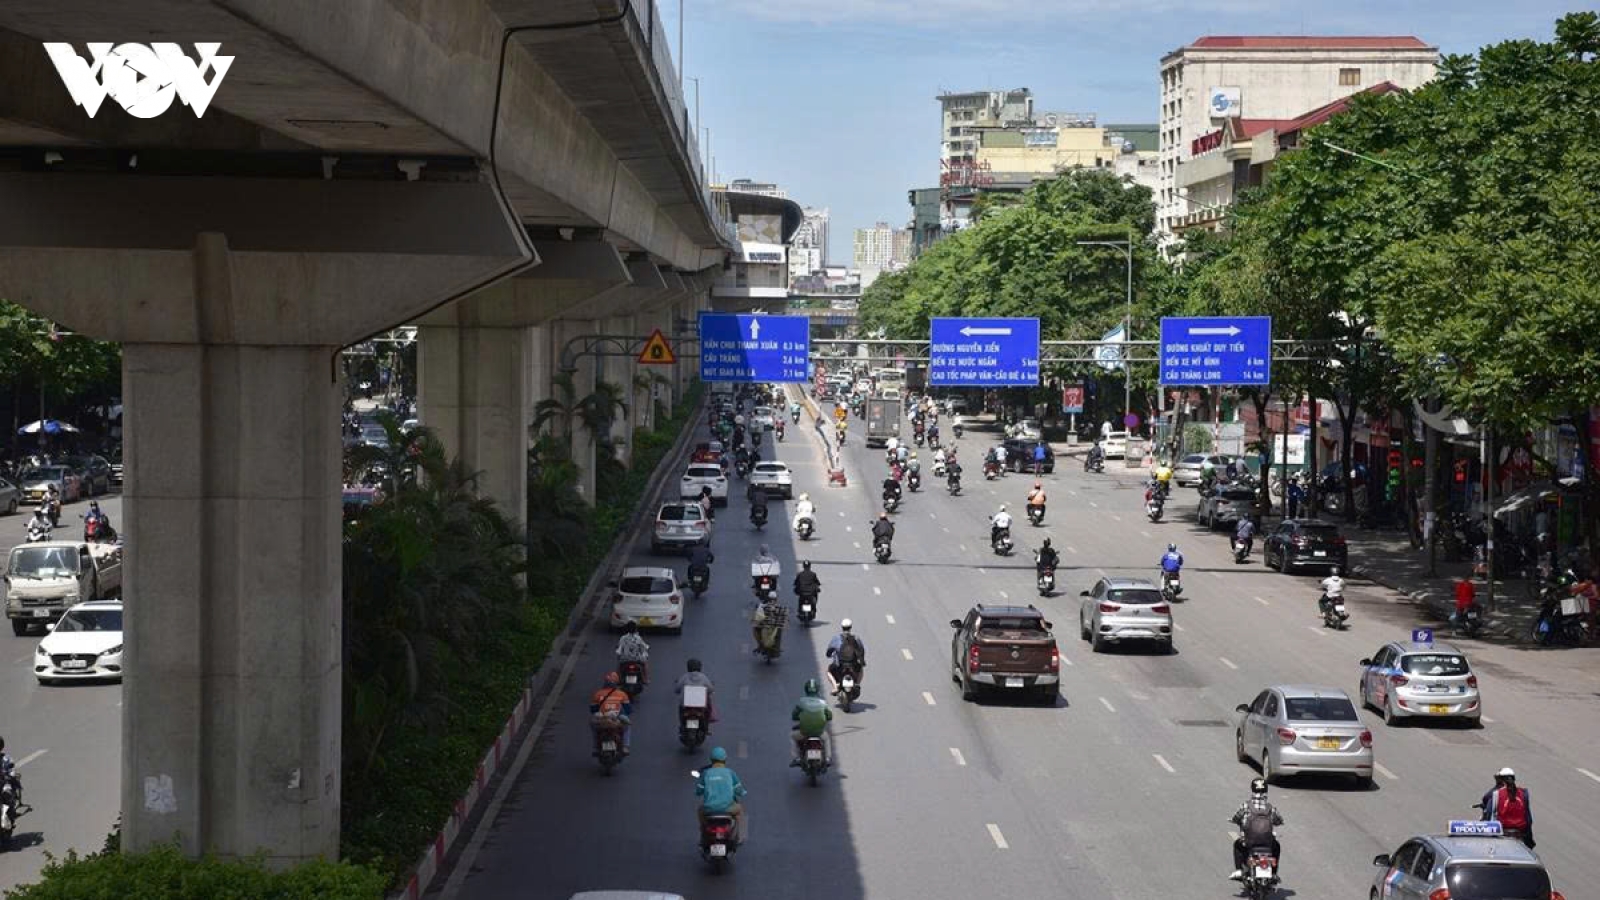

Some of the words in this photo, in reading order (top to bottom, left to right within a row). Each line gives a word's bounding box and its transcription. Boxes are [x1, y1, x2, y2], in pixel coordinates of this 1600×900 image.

[738, 340, 759, 350] THANH
[760, 340, 778, 350] XUÂN
[795, 341, 805, 350] km
[1214, 343, 1226, 353] DUY
[795, 355, 805, 365] km
[947, 357, 957, 366] XE
[1027, 358, 1038, 366] km
[1181, 357, 1190, 366] XE
[1253, 358, 1264, 366] km
[795, 369, 805, 378] km
[932, 371, 945, 380] CAO
[1027, 372, 1037, 380] km
[1203, 371, 1220, 380] LONG
[1243, 371, 1251, 380] 14
[1253, 372, 1264, 380] km
